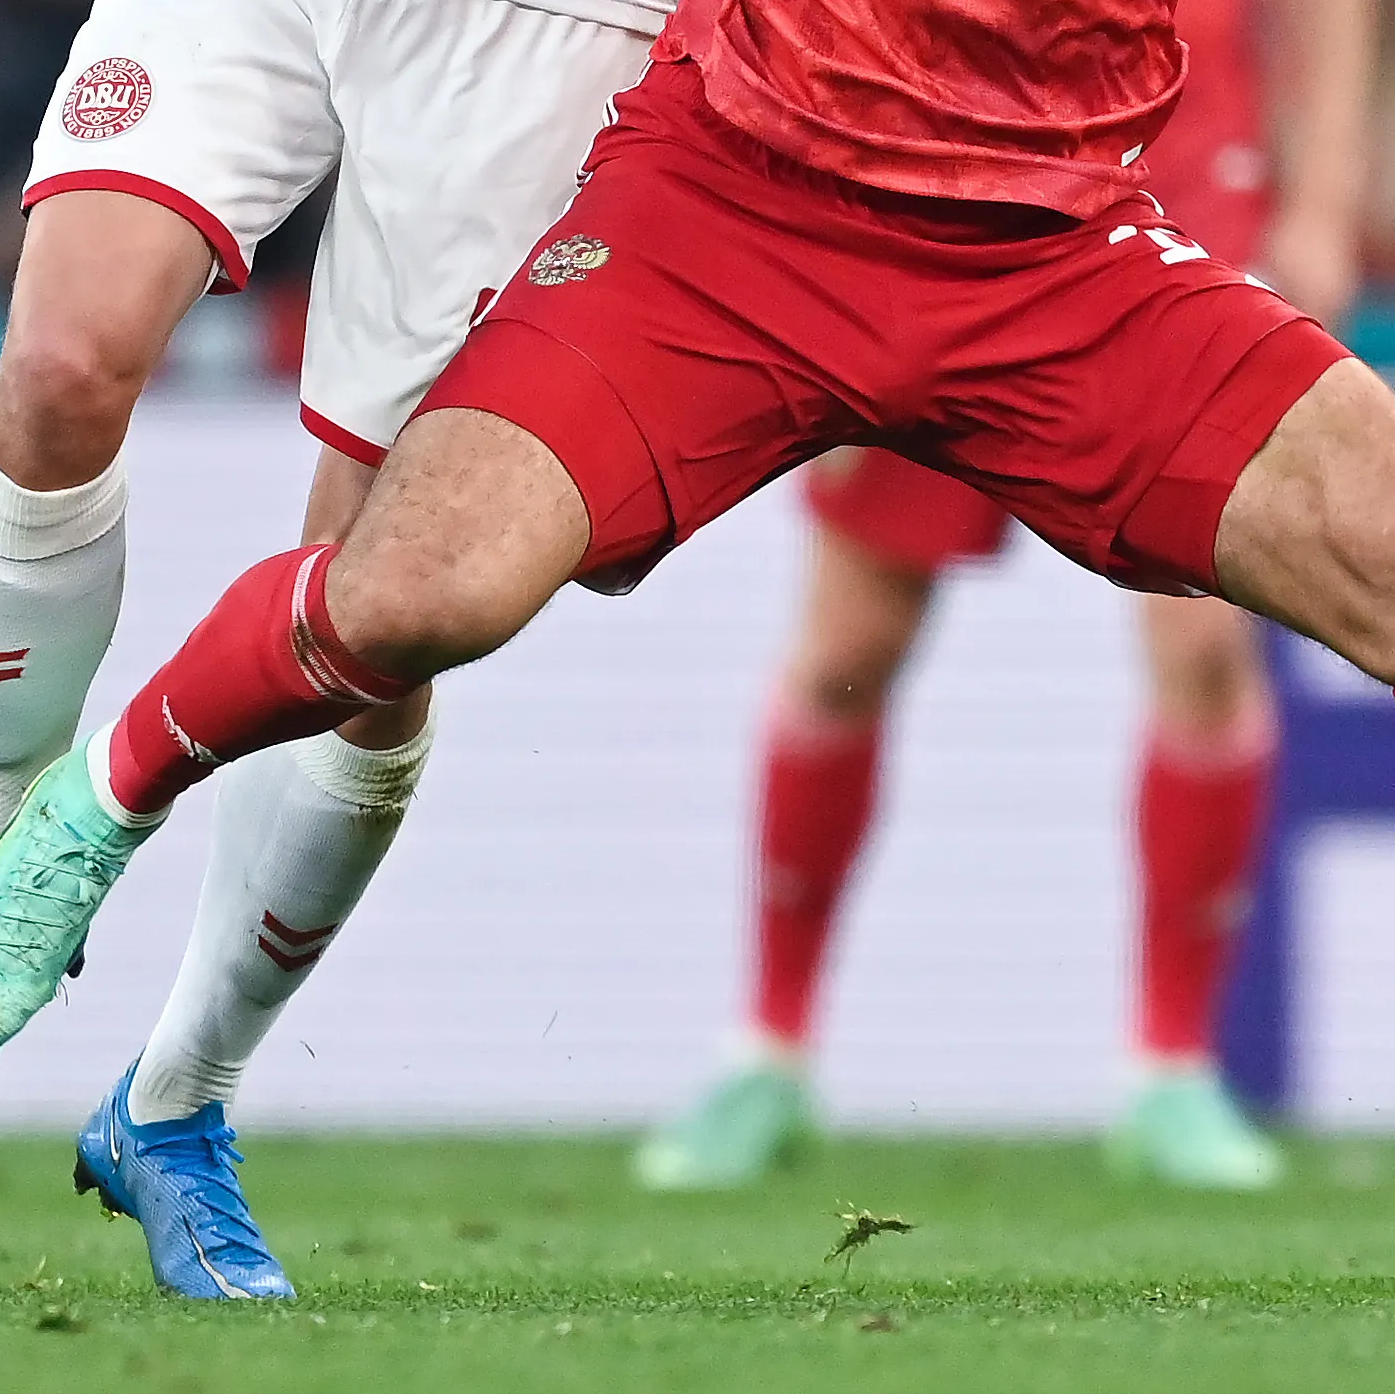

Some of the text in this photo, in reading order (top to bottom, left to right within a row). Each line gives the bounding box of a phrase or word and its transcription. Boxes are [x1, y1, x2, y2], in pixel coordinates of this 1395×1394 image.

[76, 83, 136, 110] DBU
[121, 84, 151, 130] UNION
[77, 126, 116, 139] 1889
